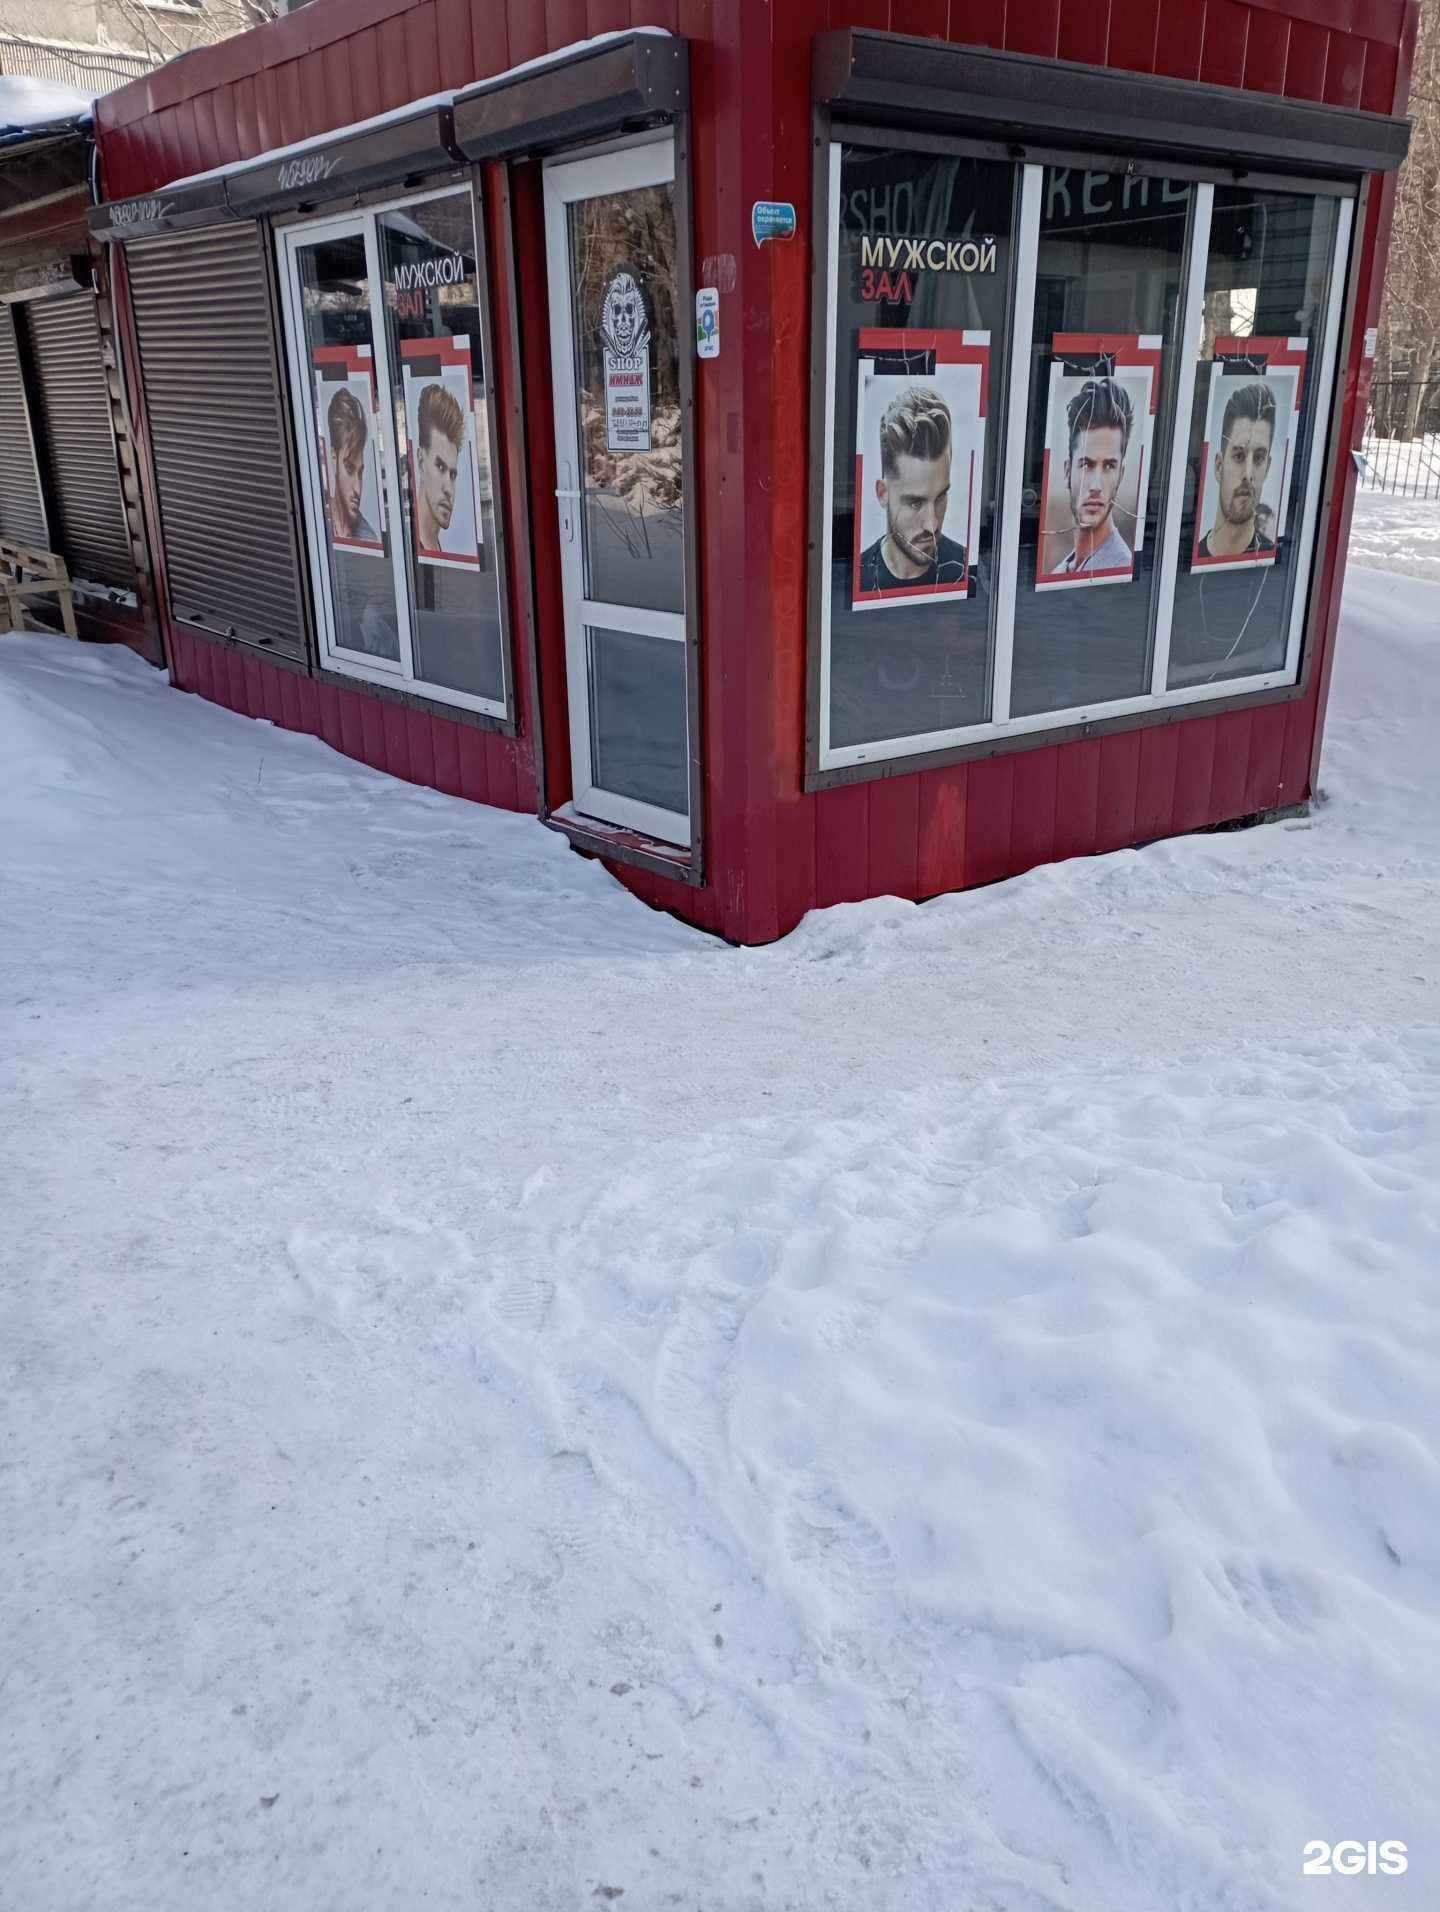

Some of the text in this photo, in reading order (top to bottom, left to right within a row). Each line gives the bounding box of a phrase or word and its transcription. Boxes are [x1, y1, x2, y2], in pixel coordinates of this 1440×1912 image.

[394, 249, 464, 291] МУЖСКОЙ
[861, 236, 997, 273] МУЖСКОЙ
[861, 267, 912, 304] ЗАЛ
[610, 357, 642, 371] SHOP
